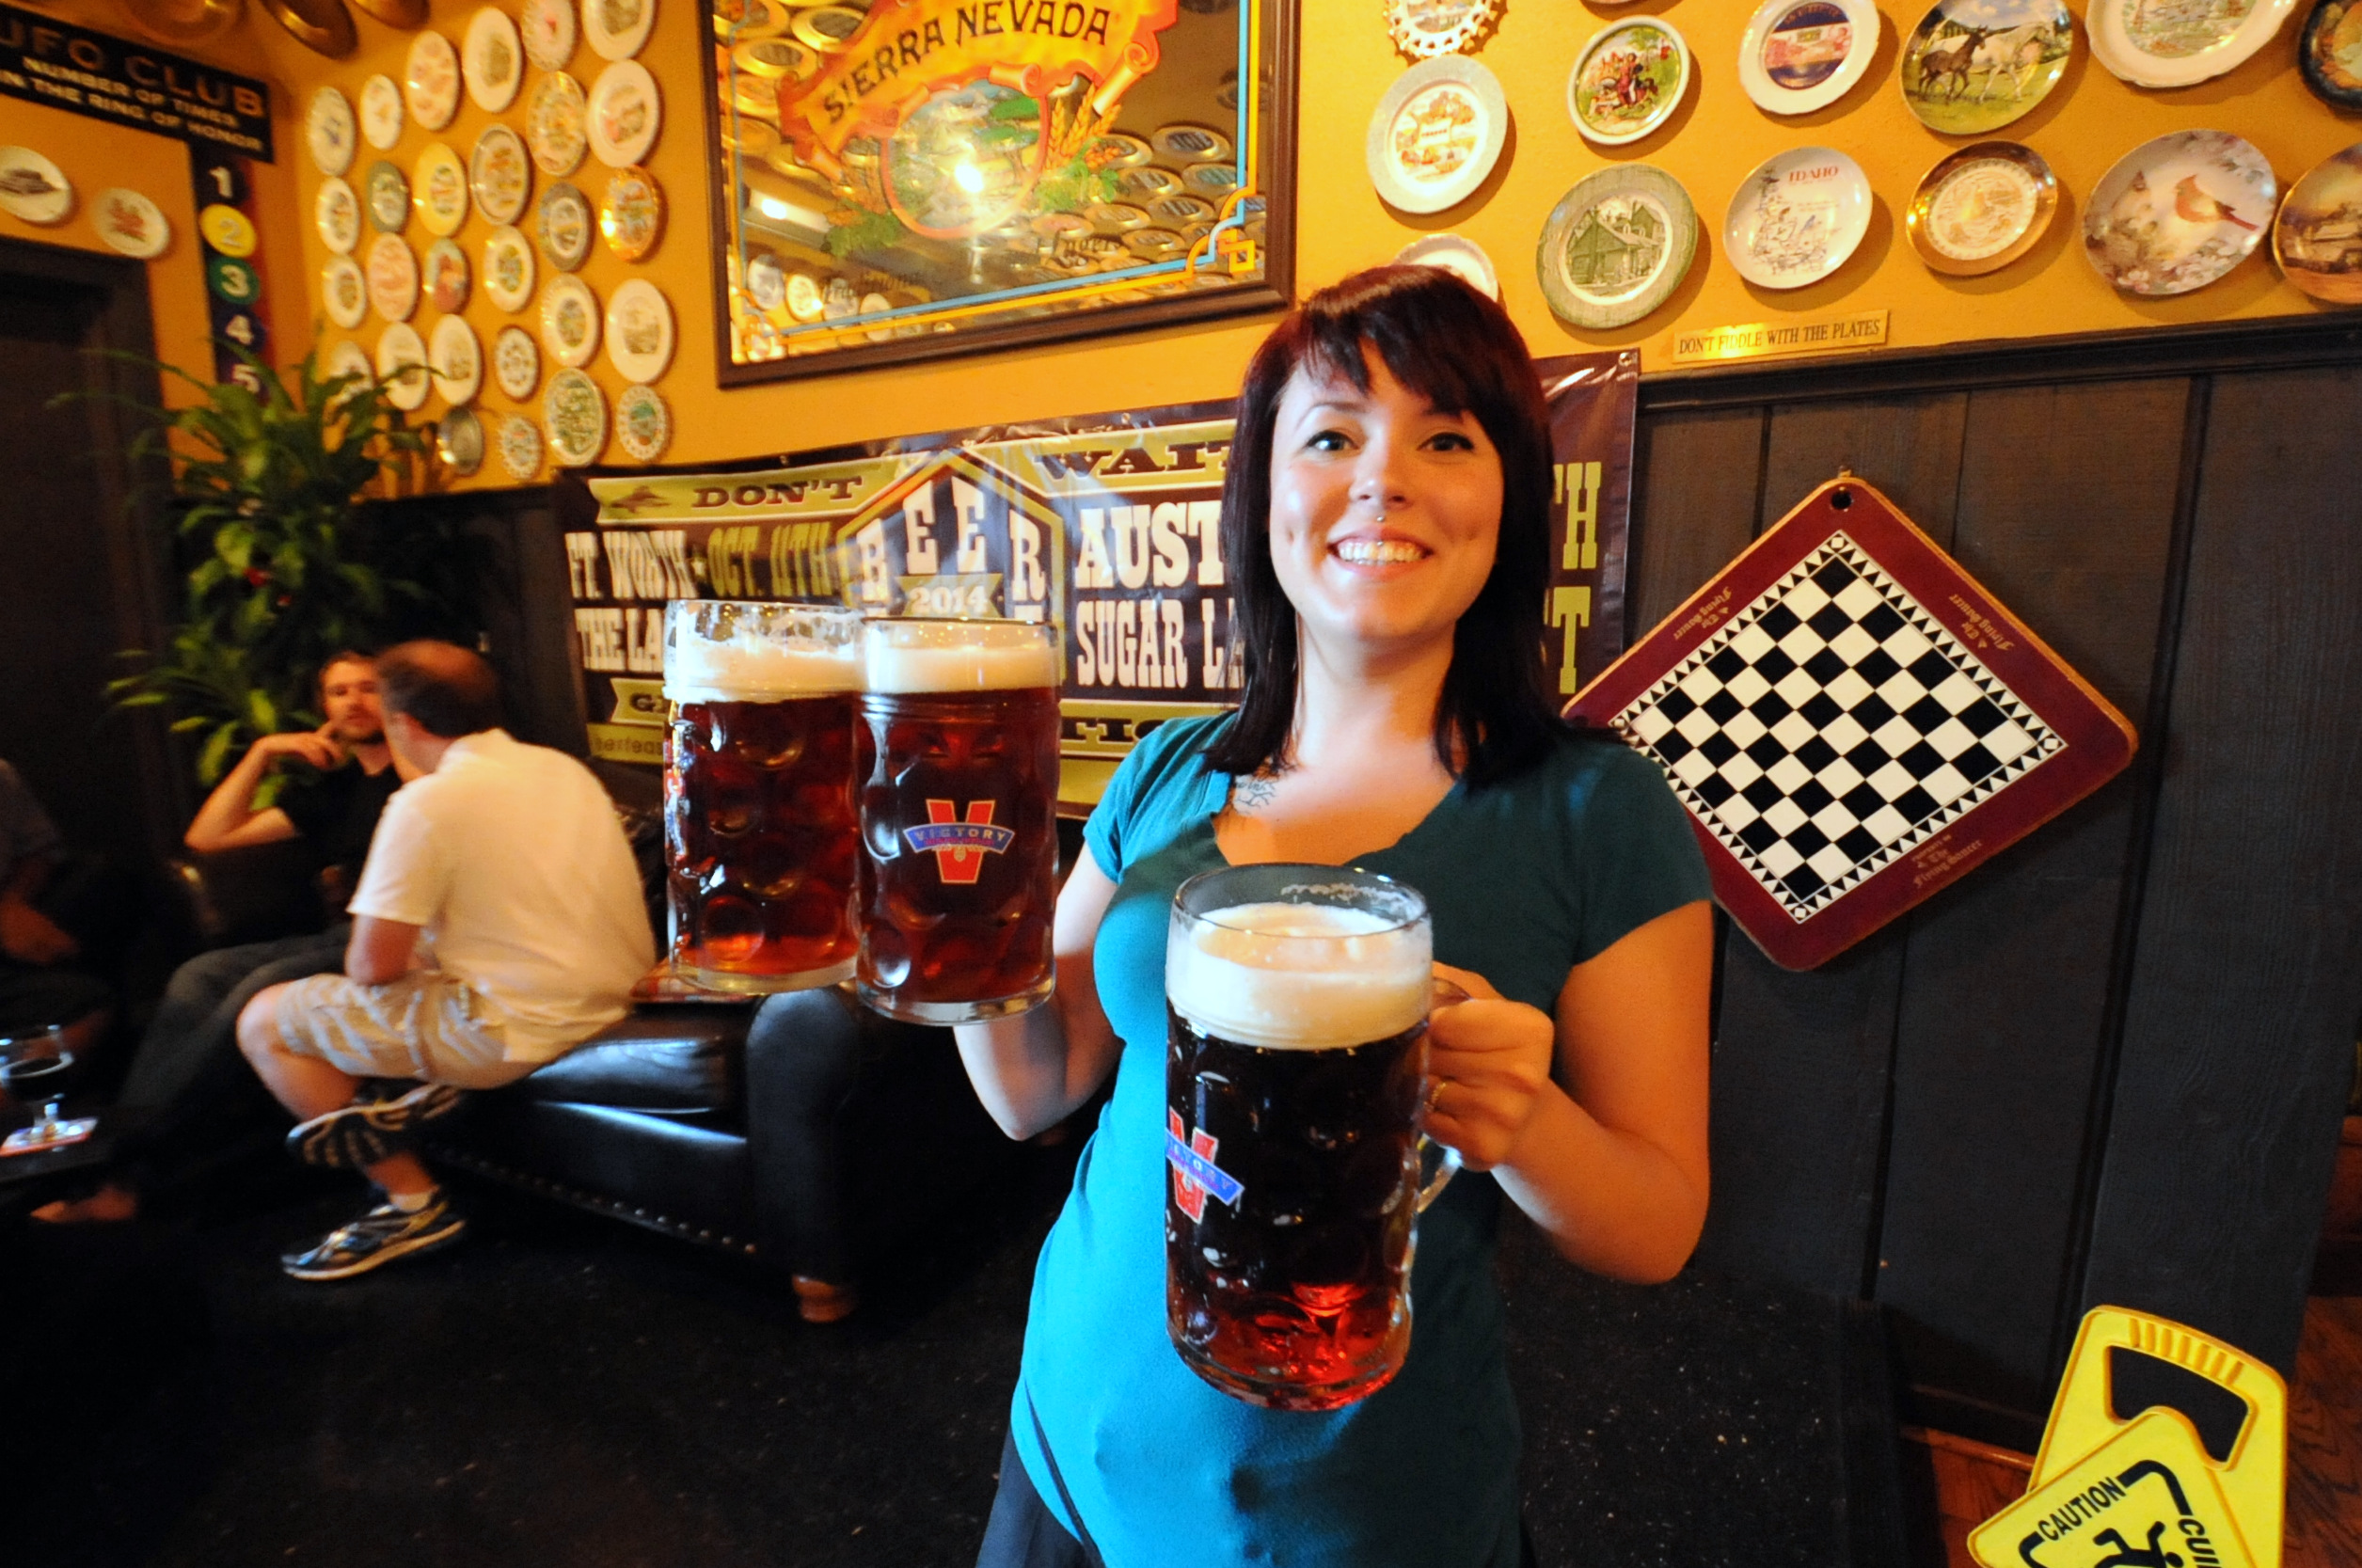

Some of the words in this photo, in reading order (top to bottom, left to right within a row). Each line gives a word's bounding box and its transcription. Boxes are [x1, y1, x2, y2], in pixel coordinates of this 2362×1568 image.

[0, 19, 102, 72] UFO
[126, 55, 263, 118] CLUB
[823, 18, 945, 125] SIERRA
[955, 0, 1111, 46] NEVADA
[23, 55, 131, 97] NUMBER
[135, 88, 166, 105] OF
[173, 98, 238, 128] TIMES
[29, 77, 82, 103] THE
[88, 93, 146, 119] RING
[151, 111, 181, 128] OF
[187, 121, 262, 150] HONOR
[210, 166, 232, 198] 1
[1789, 166, 1839, 182] IDAHO
[220, 217, 243, 247] 2
[221, 264, 250, 297] 3
[226, 314, 254, 345] 4
[1679, 336, 1714, 354] DON'T
[1718, 331, 1763, 351] FIDDLE
[1767, 327, 1799, 345] WITH
[1803, 325, 1828, 341] THE
[1832, 319, 1880, 339] PLATES
[232, 363, 261, 393] 5
[691, 475, 863, 509] DON'T
[856, 475, 1046, 602] BEER
[603, 530, 698, 599] WORTH
[909, 585, 989, 615] 2014
[574, 608, 625, 670] THE
[1076, 598, 1188, 689] SUGAR
[914, 828, 1006, 842] VICTORY
[2037, 1476, 2126, 1541] CAUTION
[2178, 1518, 2222, 1568] CUI
